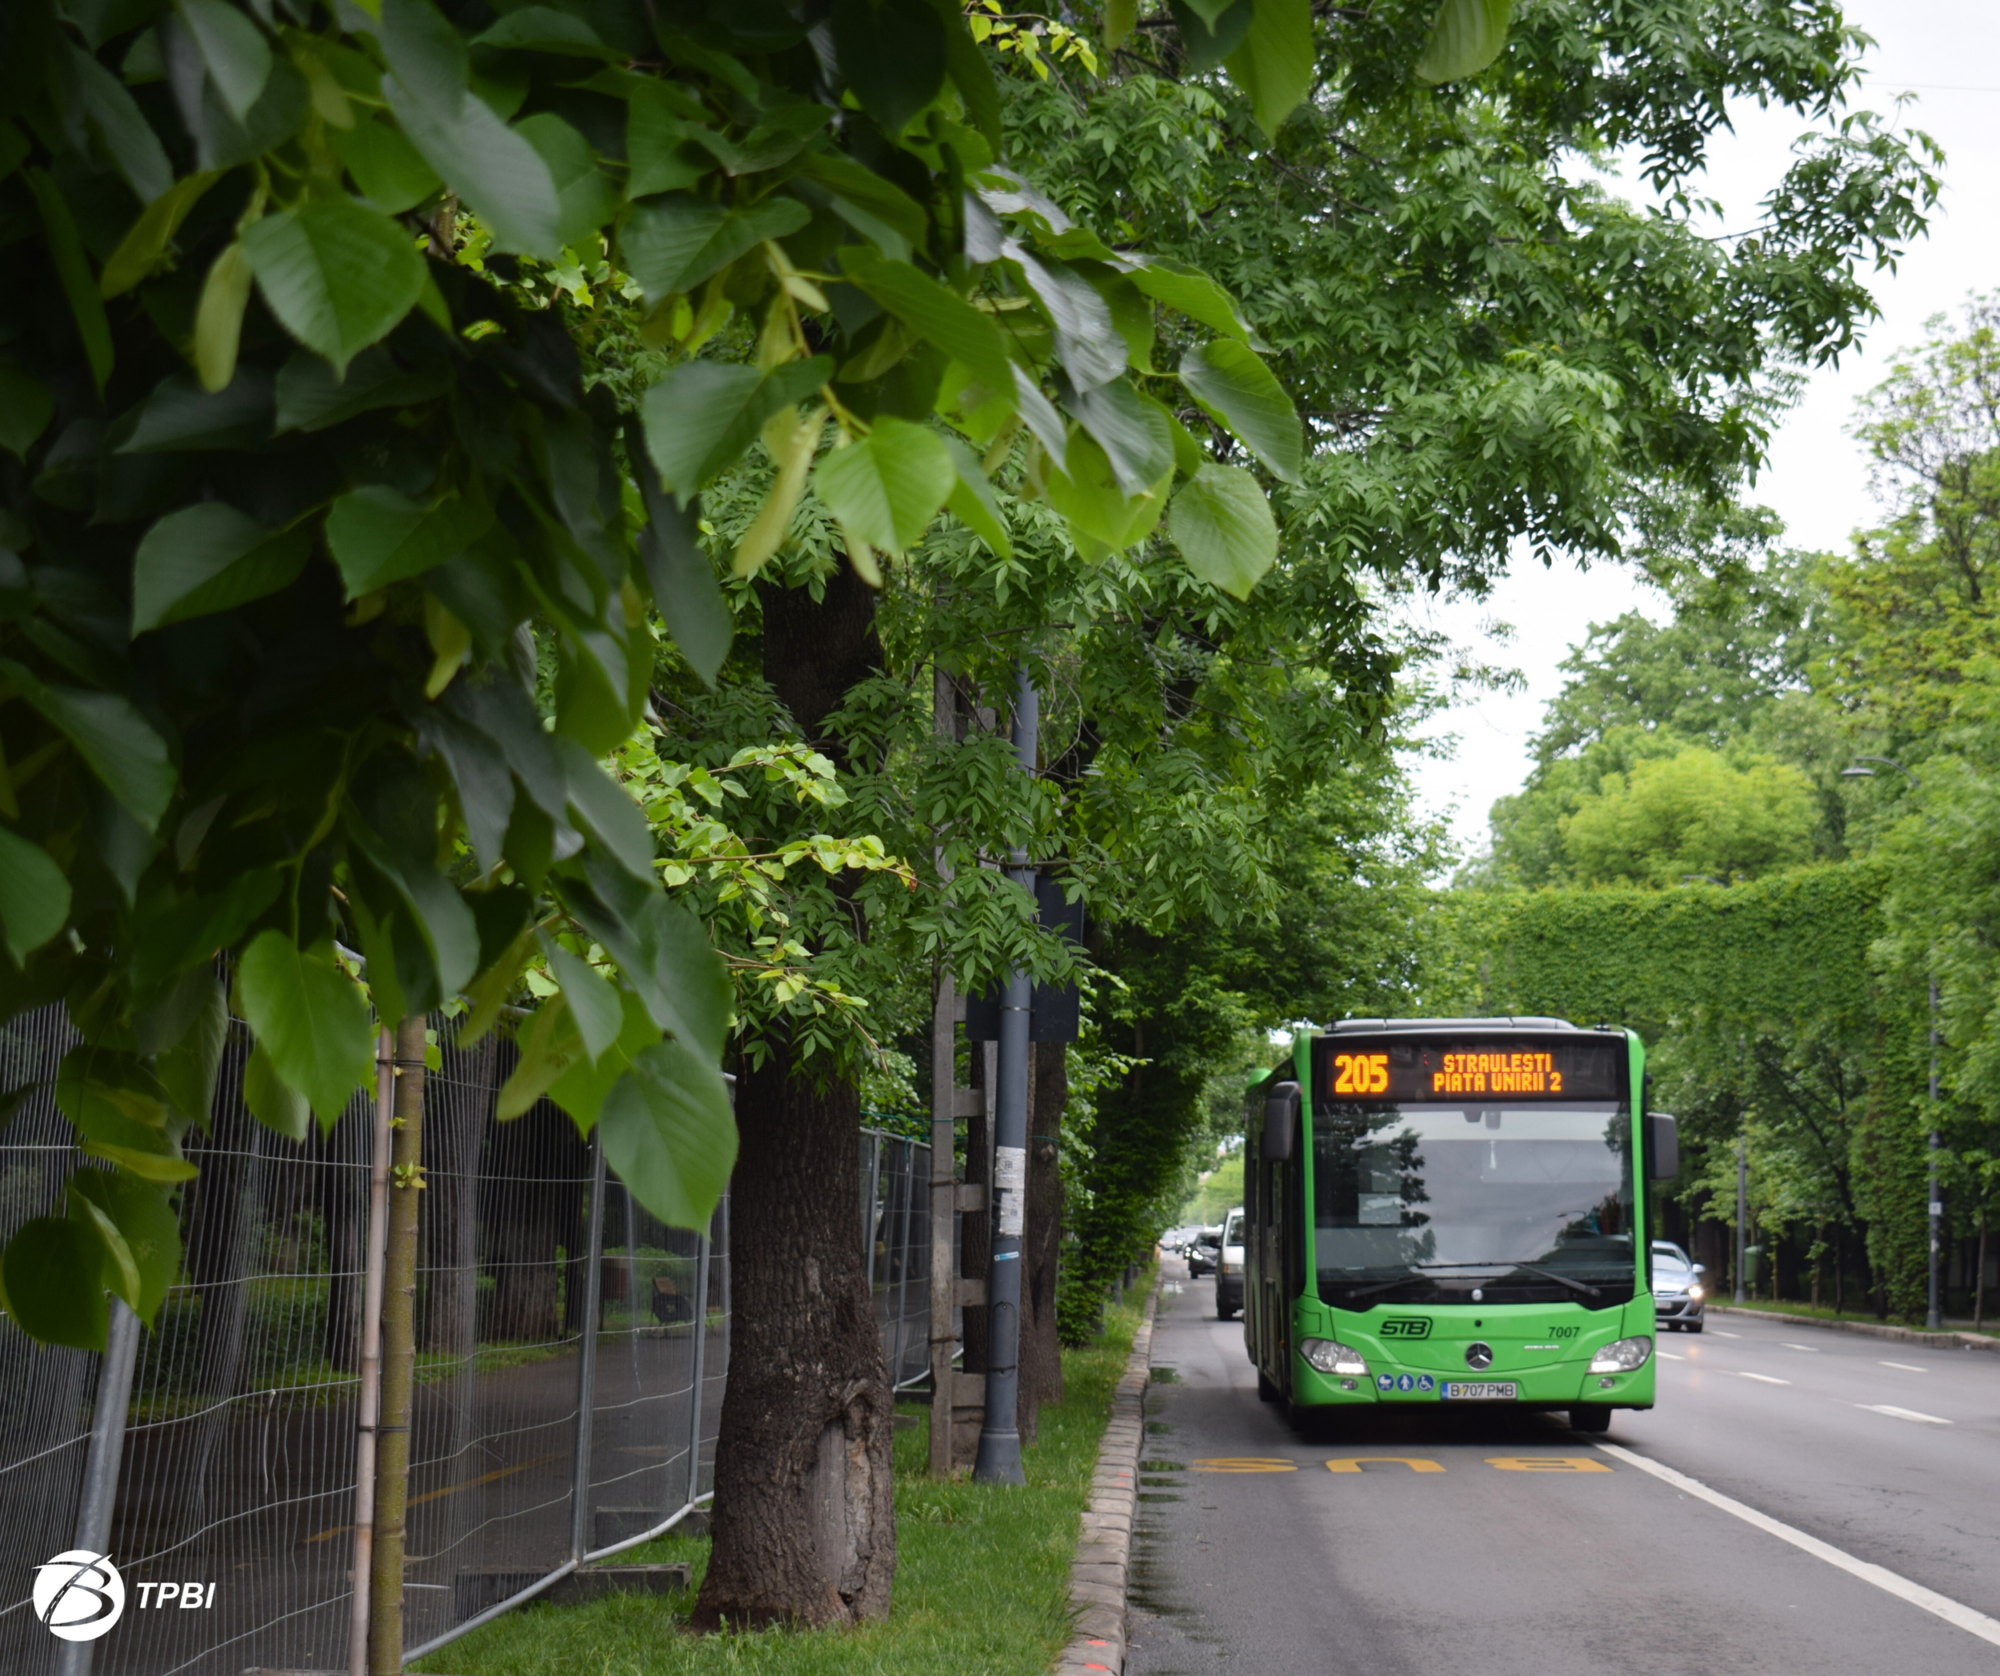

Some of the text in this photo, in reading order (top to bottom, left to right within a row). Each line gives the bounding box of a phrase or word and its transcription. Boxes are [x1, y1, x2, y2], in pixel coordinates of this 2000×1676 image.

[1443, 1053, 1552, 1073] STRAULESTI
[1335, 1055, 1388, 1093] 205
[1433, 1072, 1562, 1092] PIATA UNIRII 2
[1379, 1320, 1428, 1336] STB
[1548, 1326, 1580, 1338] 7007
[1487, 1384, 1514, 1397] PMB
